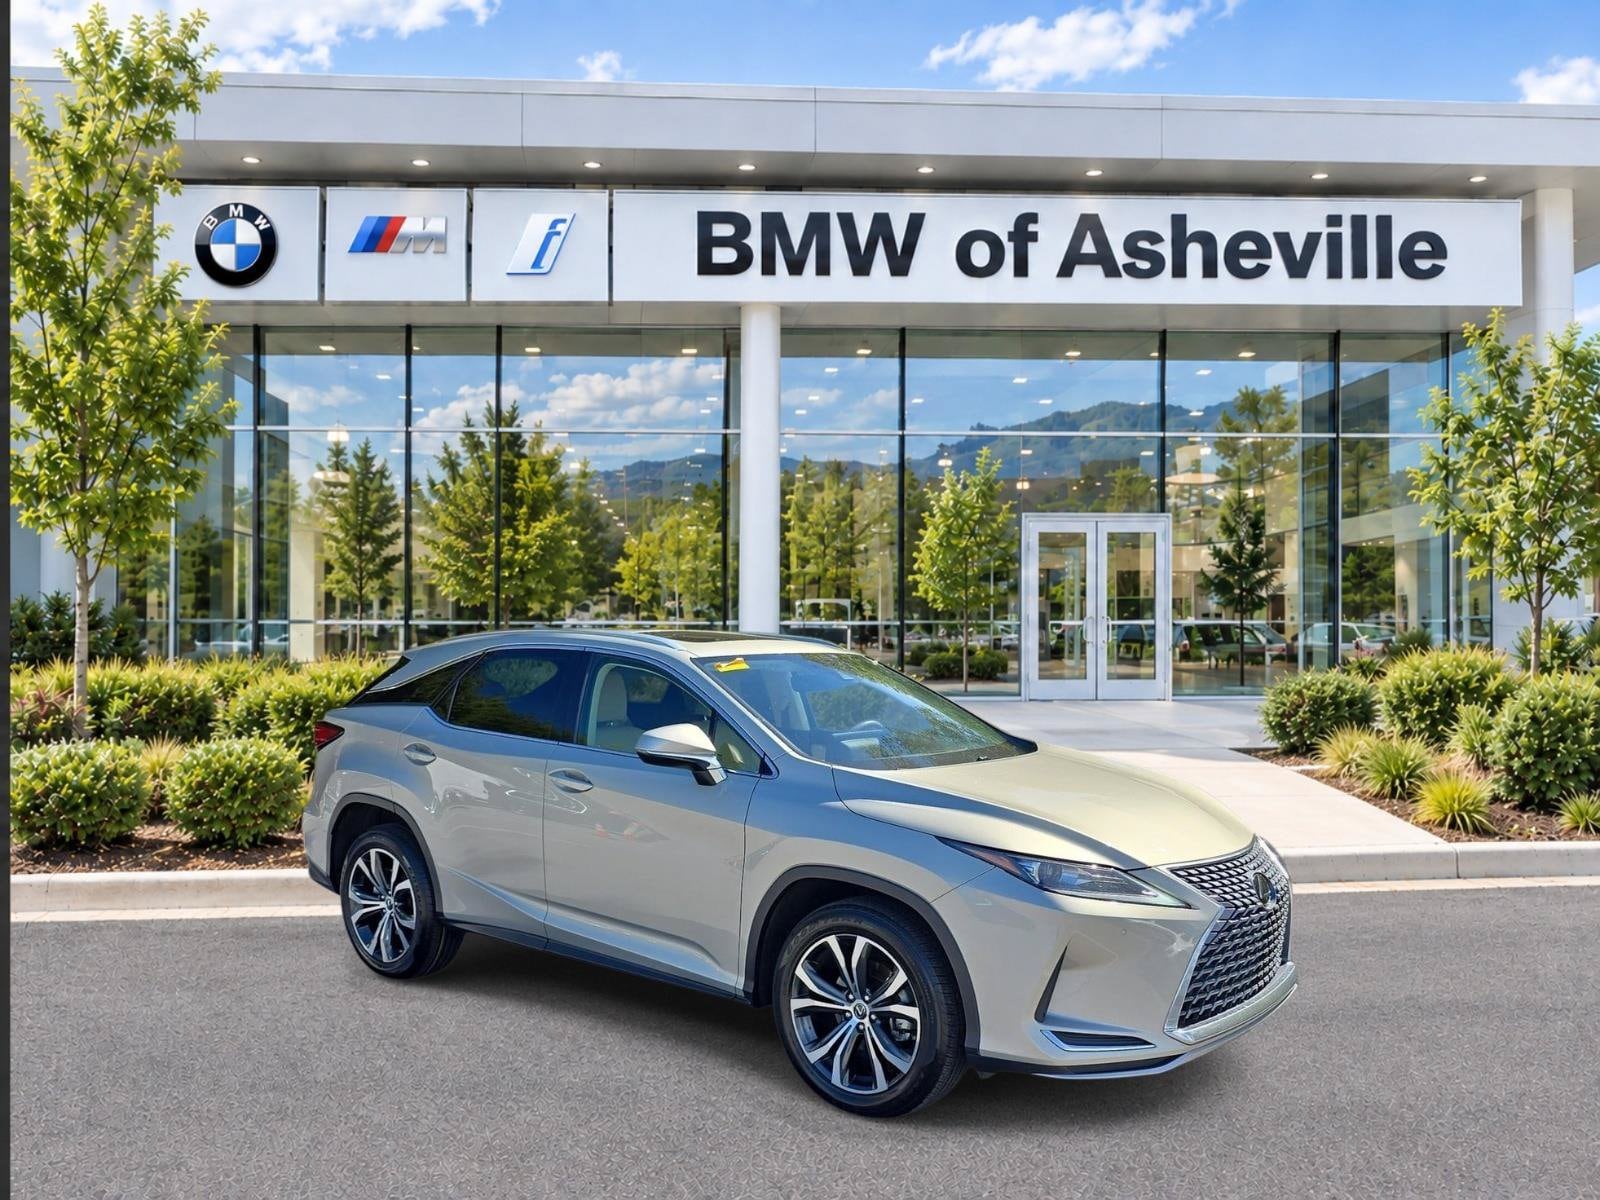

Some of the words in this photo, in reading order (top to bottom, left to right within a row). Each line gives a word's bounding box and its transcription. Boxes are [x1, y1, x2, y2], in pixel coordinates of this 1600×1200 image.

[203, 204, 271, 230] BMW
[697, 210, 926, 277] BMW
[955, 212, 1039, 279] of
[1056, 213, 1448, 280] Asheville
